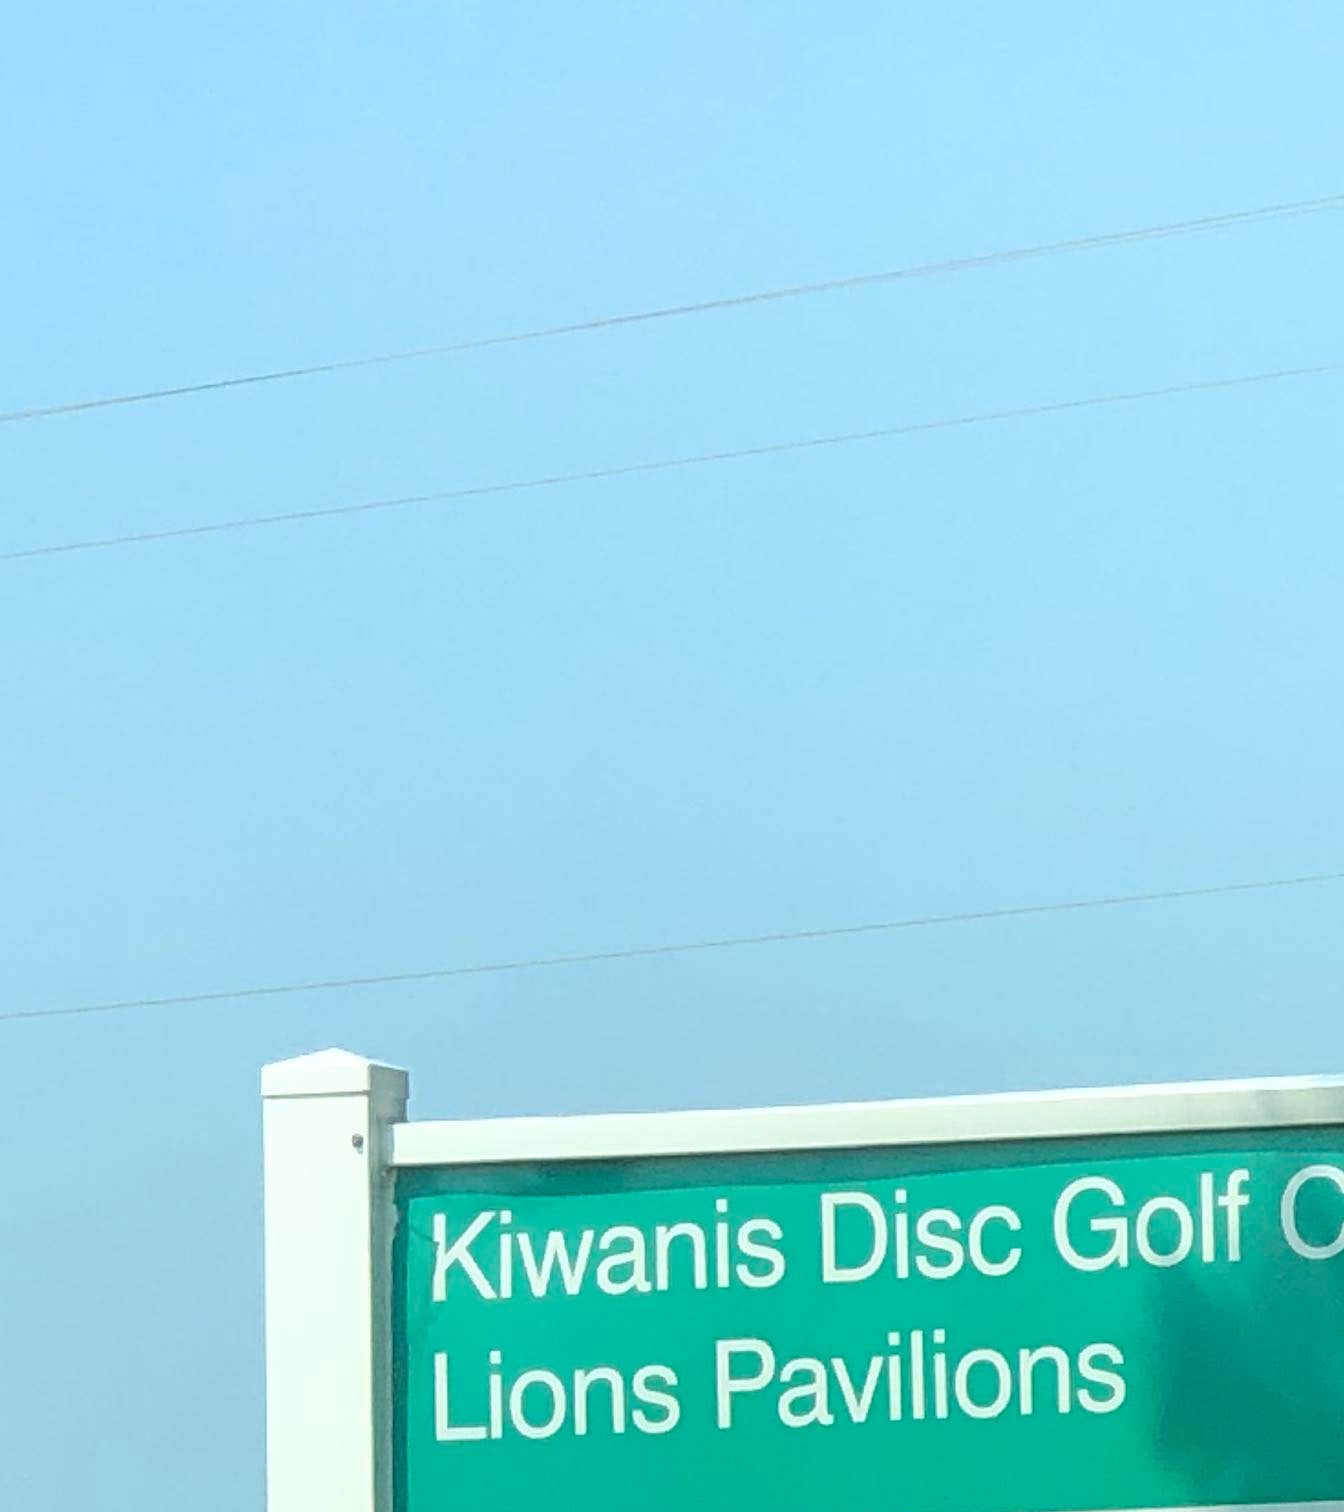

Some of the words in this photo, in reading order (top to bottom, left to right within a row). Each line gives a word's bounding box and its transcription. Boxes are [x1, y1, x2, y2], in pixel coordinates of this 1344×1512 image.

[431, 1197, 787, 1303] Kiwanis
[819, 1187, 1023, 1284] Disc
[1052, 1167, 1251, 1272] Golf
[433, 1349, 681, 1442] Lions
[715, 1328, 1127, 1430] Pavilions
